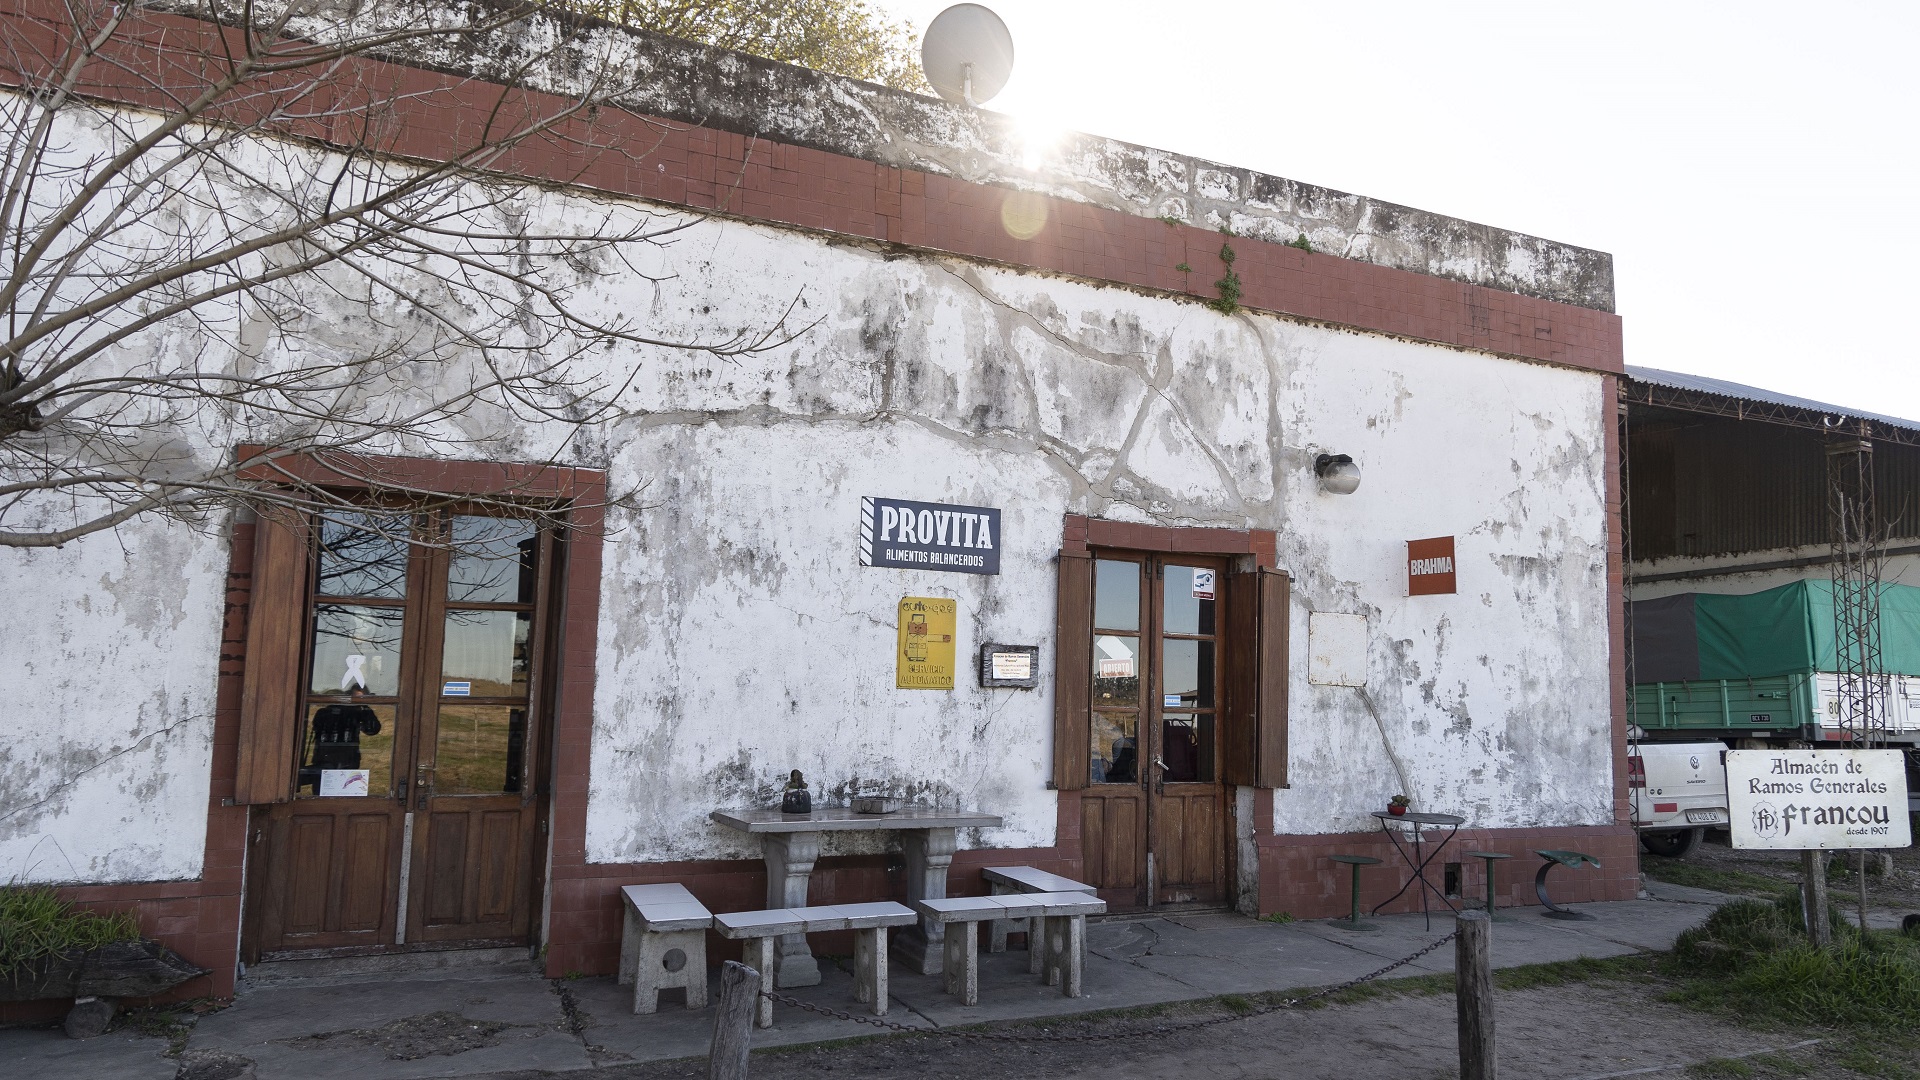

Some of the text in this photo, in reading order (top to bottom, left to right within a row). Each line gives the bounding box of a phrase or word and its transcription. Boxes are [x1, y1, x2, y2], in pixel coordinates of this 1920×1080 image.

[880, 505, 993, 550] PROVITA
[886, 549, 984, 567] ALIMENTOS BALANCEADOS
[1410, 557, 1453, 576] BRAHMA
[908, 663, 945, 674] SERVICIO
[1103, 662, 1131, 673] ABIERTO
[1828, 701, 1839, 715] 80
[1770, 758, 1862, 774] Almacén de
[1749, 777, 1887, 794] Ramos Generales
[1846, 826, 1889, 835] desde 1907
